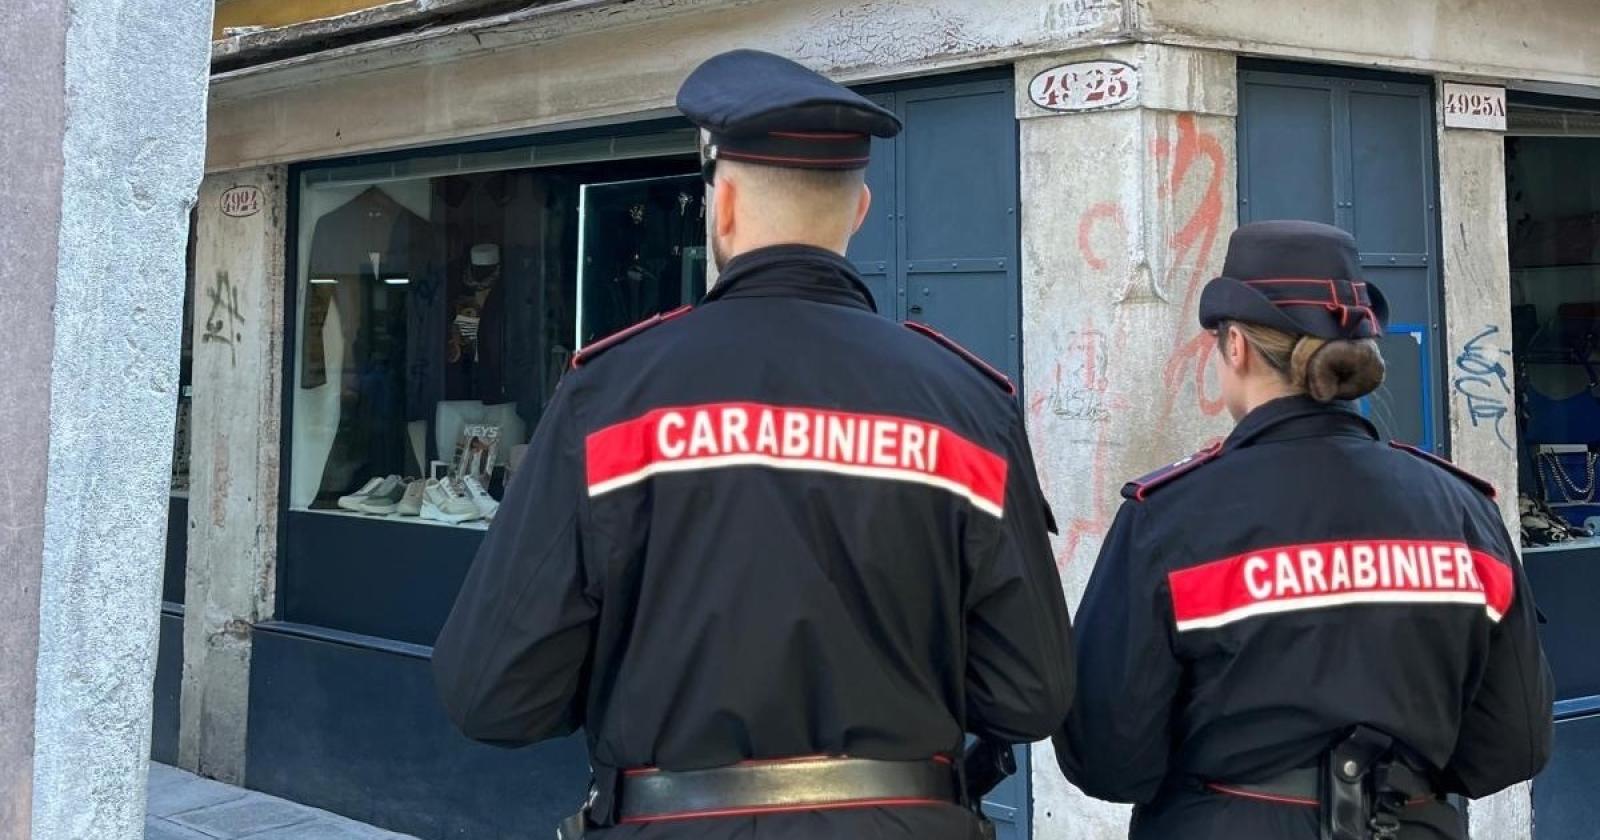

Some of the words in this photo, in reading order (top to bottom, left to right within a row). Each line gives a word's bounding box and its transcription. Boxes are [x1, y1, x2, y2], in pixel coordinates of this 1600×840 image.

[1444, 93, 1505, 117] 4925A
[223, 190, 258, 213] 4924
[656, 407, 940, 473] CARABINIERI
[1243, 544, 1484, 599] CARABINIER
